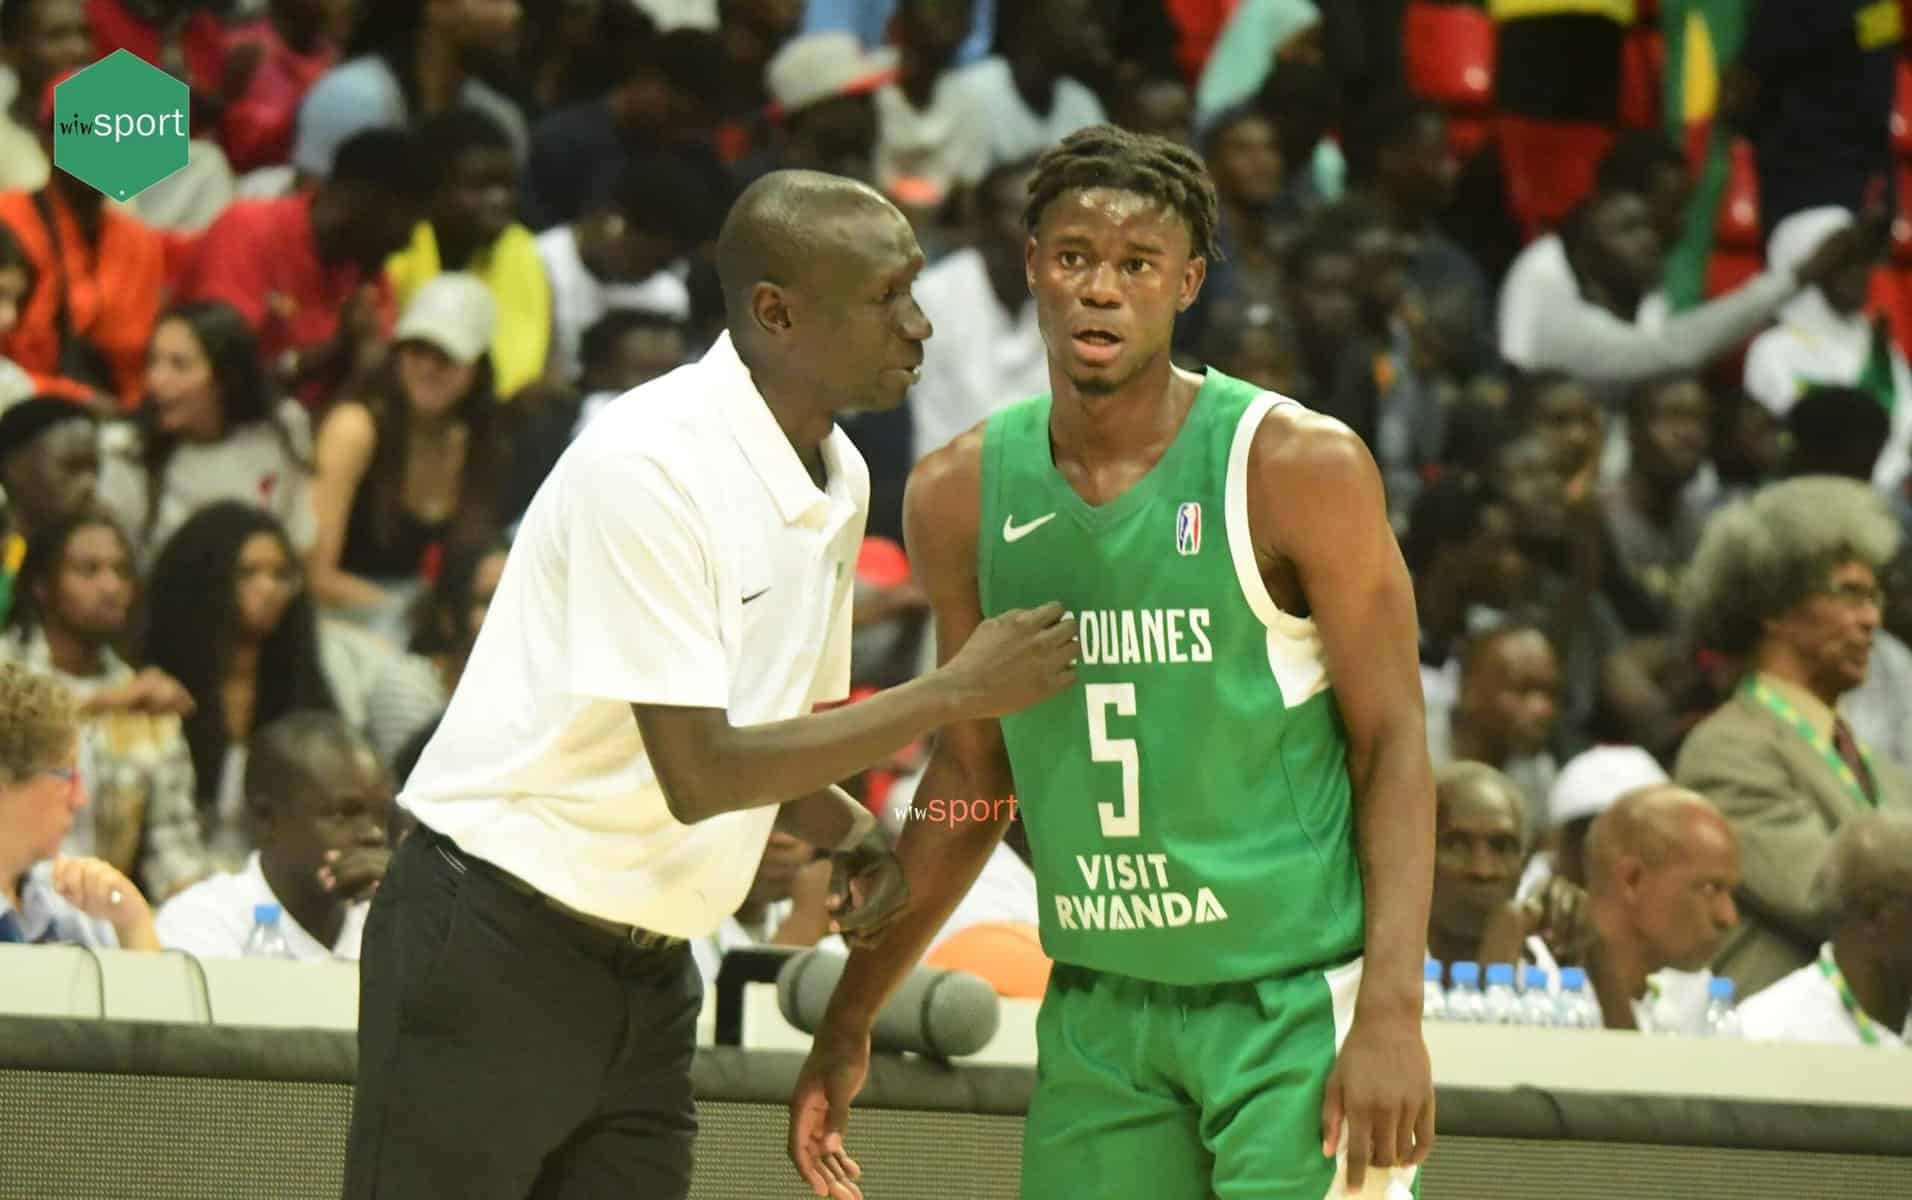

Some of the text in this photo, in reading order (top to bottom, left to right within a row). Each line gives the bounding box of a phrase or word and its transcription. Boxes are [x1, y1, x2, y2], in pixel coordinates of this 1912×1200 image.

[1060, 608, 1213, 665] OUANES
[1085, 682, 1140, 837] 5
[1076, 853, 1169, 890] VISIT
[1055, 886, 1228, 931] RWANDA
